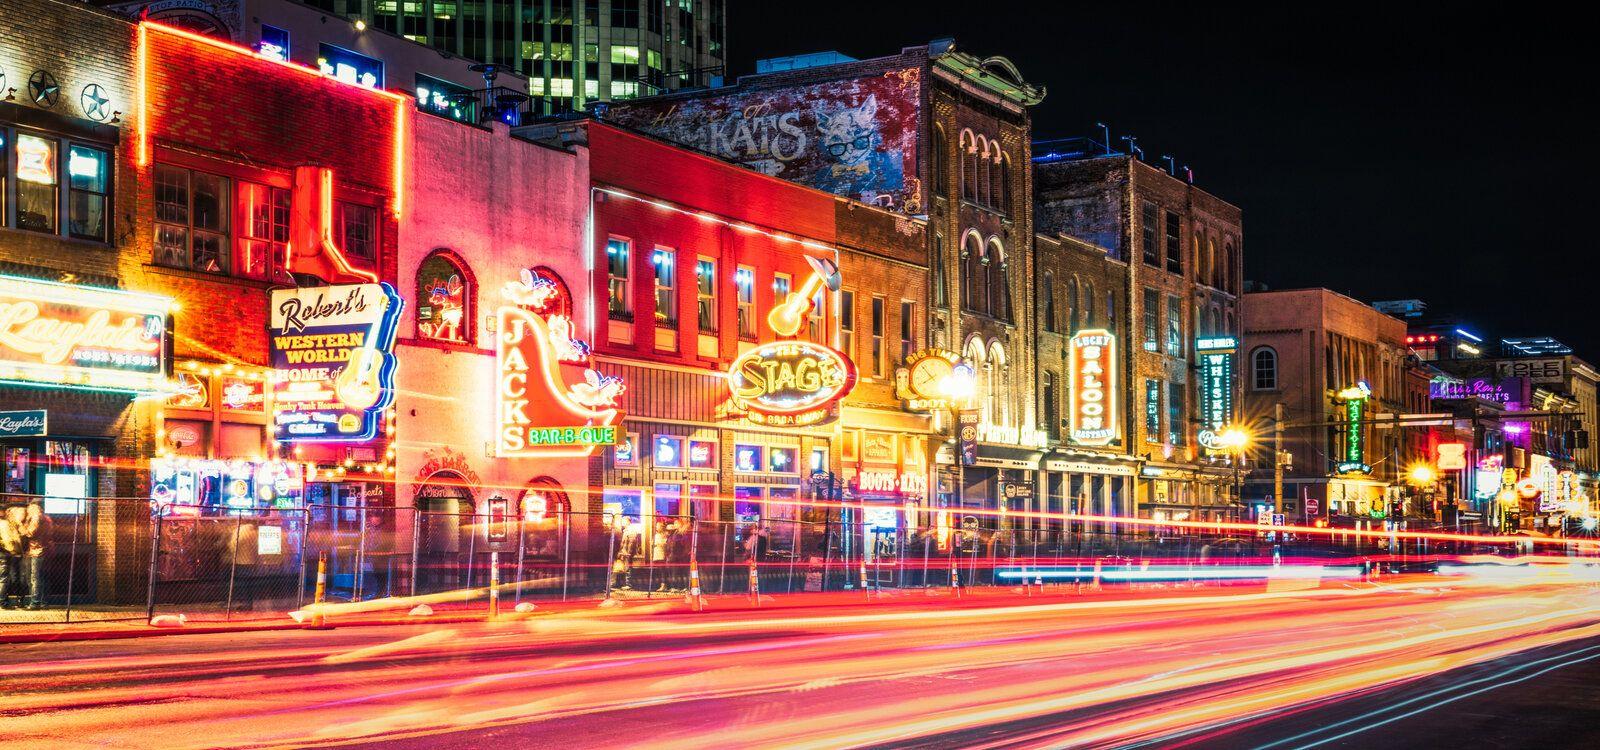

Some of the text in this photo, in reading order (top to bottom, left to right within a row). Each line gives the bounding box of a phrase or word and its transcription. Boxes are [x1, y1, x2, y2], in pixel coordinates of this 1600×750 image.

[710, 111, 807, 161] KATS
[279, 287, 367, 335] Robert's
[0, 300, 158, 364] Layla's
[274, 332, 365, 350] WESTERN
[1076, 336, 1111, 347] LUCKY
[285, 349, 351, 364] WORLD
[776, 345, 799, 356] THE
[906, 348, 960, 364] BIG TIME
[1513, 361, 1560, 370] OLE
[274, 366, 344, 382] HOME of
[737, 354, 843, 399] STAGE
[503, 319, 531, 450] JACKS
[1080, 346, 1104, 430] SALOON
[1209, 354, 1224, 431] WHISKEY
[273, 402, 346, 412] Honky Tonk Heaven
[0, 416, 45, 433] Layla's
[748, 410, 829, 424] ON BROADWAY
[528, 428, 615, 444] BAR-B-QUE
[1074, 430, 1114, 438] BASTARD
[860, 471, 926, 492] BOOTS HATS
[349, 484, 383, 499] Robert's
